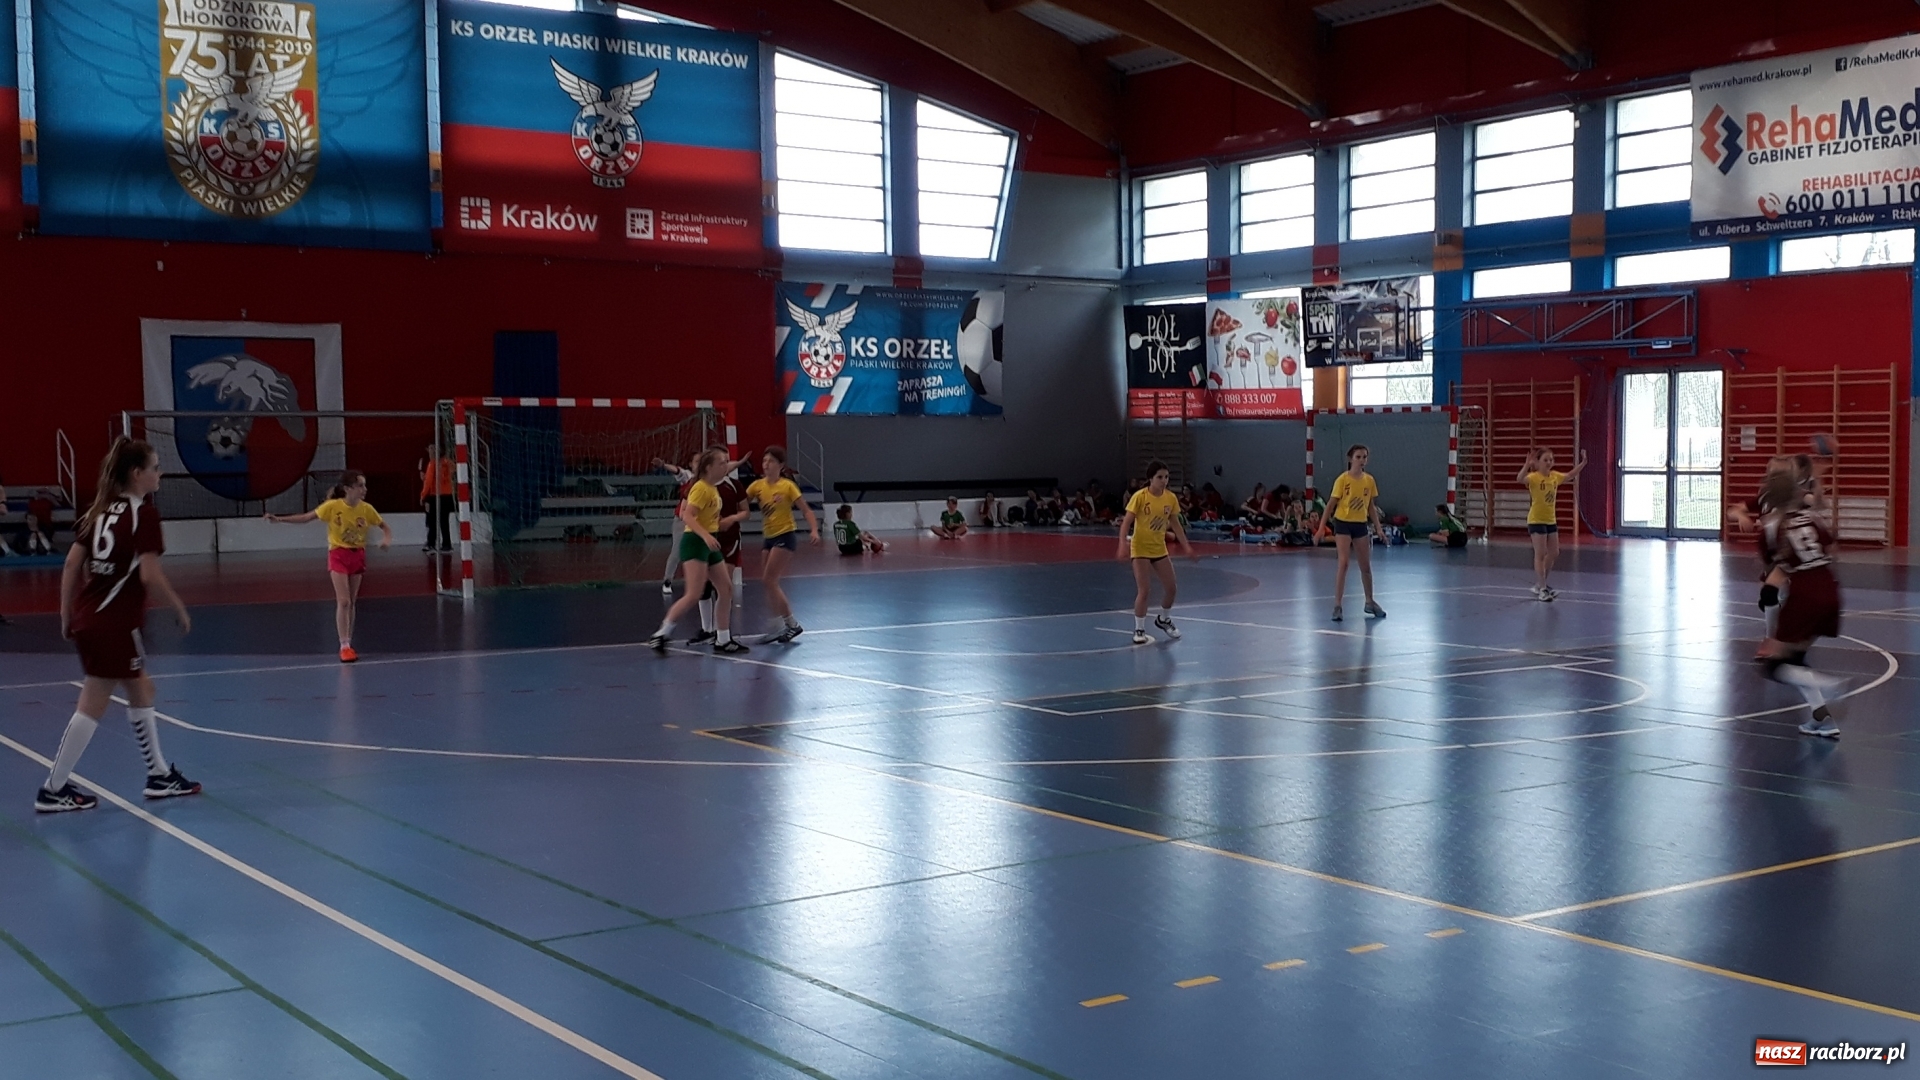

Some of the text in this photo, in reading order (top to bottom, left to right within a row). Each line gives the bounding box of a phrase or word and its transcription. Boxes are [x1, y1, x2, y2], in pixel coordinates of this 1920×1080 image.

[193, 0, 283, 18] ODZNAKA
[183, 10, 294, 35] HONOROWA
[163, 28, 227, 78] 75
[227, 34, 313, 56] 1944-2019
[451, 19, 749, 69] KS ORZEŁ PIASKI WIELKIE KRAKÓW
[228, 49, 291, 77] LAT
[1699, 64, 1812, 92] www.rehamed.krakow.pl
[1746, 87, 1920, 151] RehaMed
[578, 145, 638, 175] ORZEŁ
[1748, 130, 1920, 165] GABINET FIZJOTERAPI
[207, 144, 281, 178] ORZEŁ
[1802, 166, 1920, 192] REHABILITACJA
[180, 168, 235, 213] PIASKI
[241, 175, 307, 216] WIELKIE
[1785, 181, 1920, 214] 600 011 110
[502, 203, 599, 232] Kraków
[661, 210, 748, 228] Zarząd Infrastruktury
[661, 221, 703, 236] Sportowej
[1699, 227, 1710, 237] ul.
[1716, 223, 1751, 235] Alberta
[1755, 219, 1813, 232] Schweitzera
[1819, 216, 1829, 227] 7,
[1834, 213, 1875, 225] Kraków
[661, 233, 709, 244] w Krakowie
[850, 336, 953, 359] KS ORZEŁ
[850, 359, 953, 370] PIASKI WIELKIE KRAKÓW
[898, 374, 943, 391] ZAPRASZA
[904, 384, 967, 403] NA TRENINGI!
[1224, 392, 1277, 404] 888 333 007
